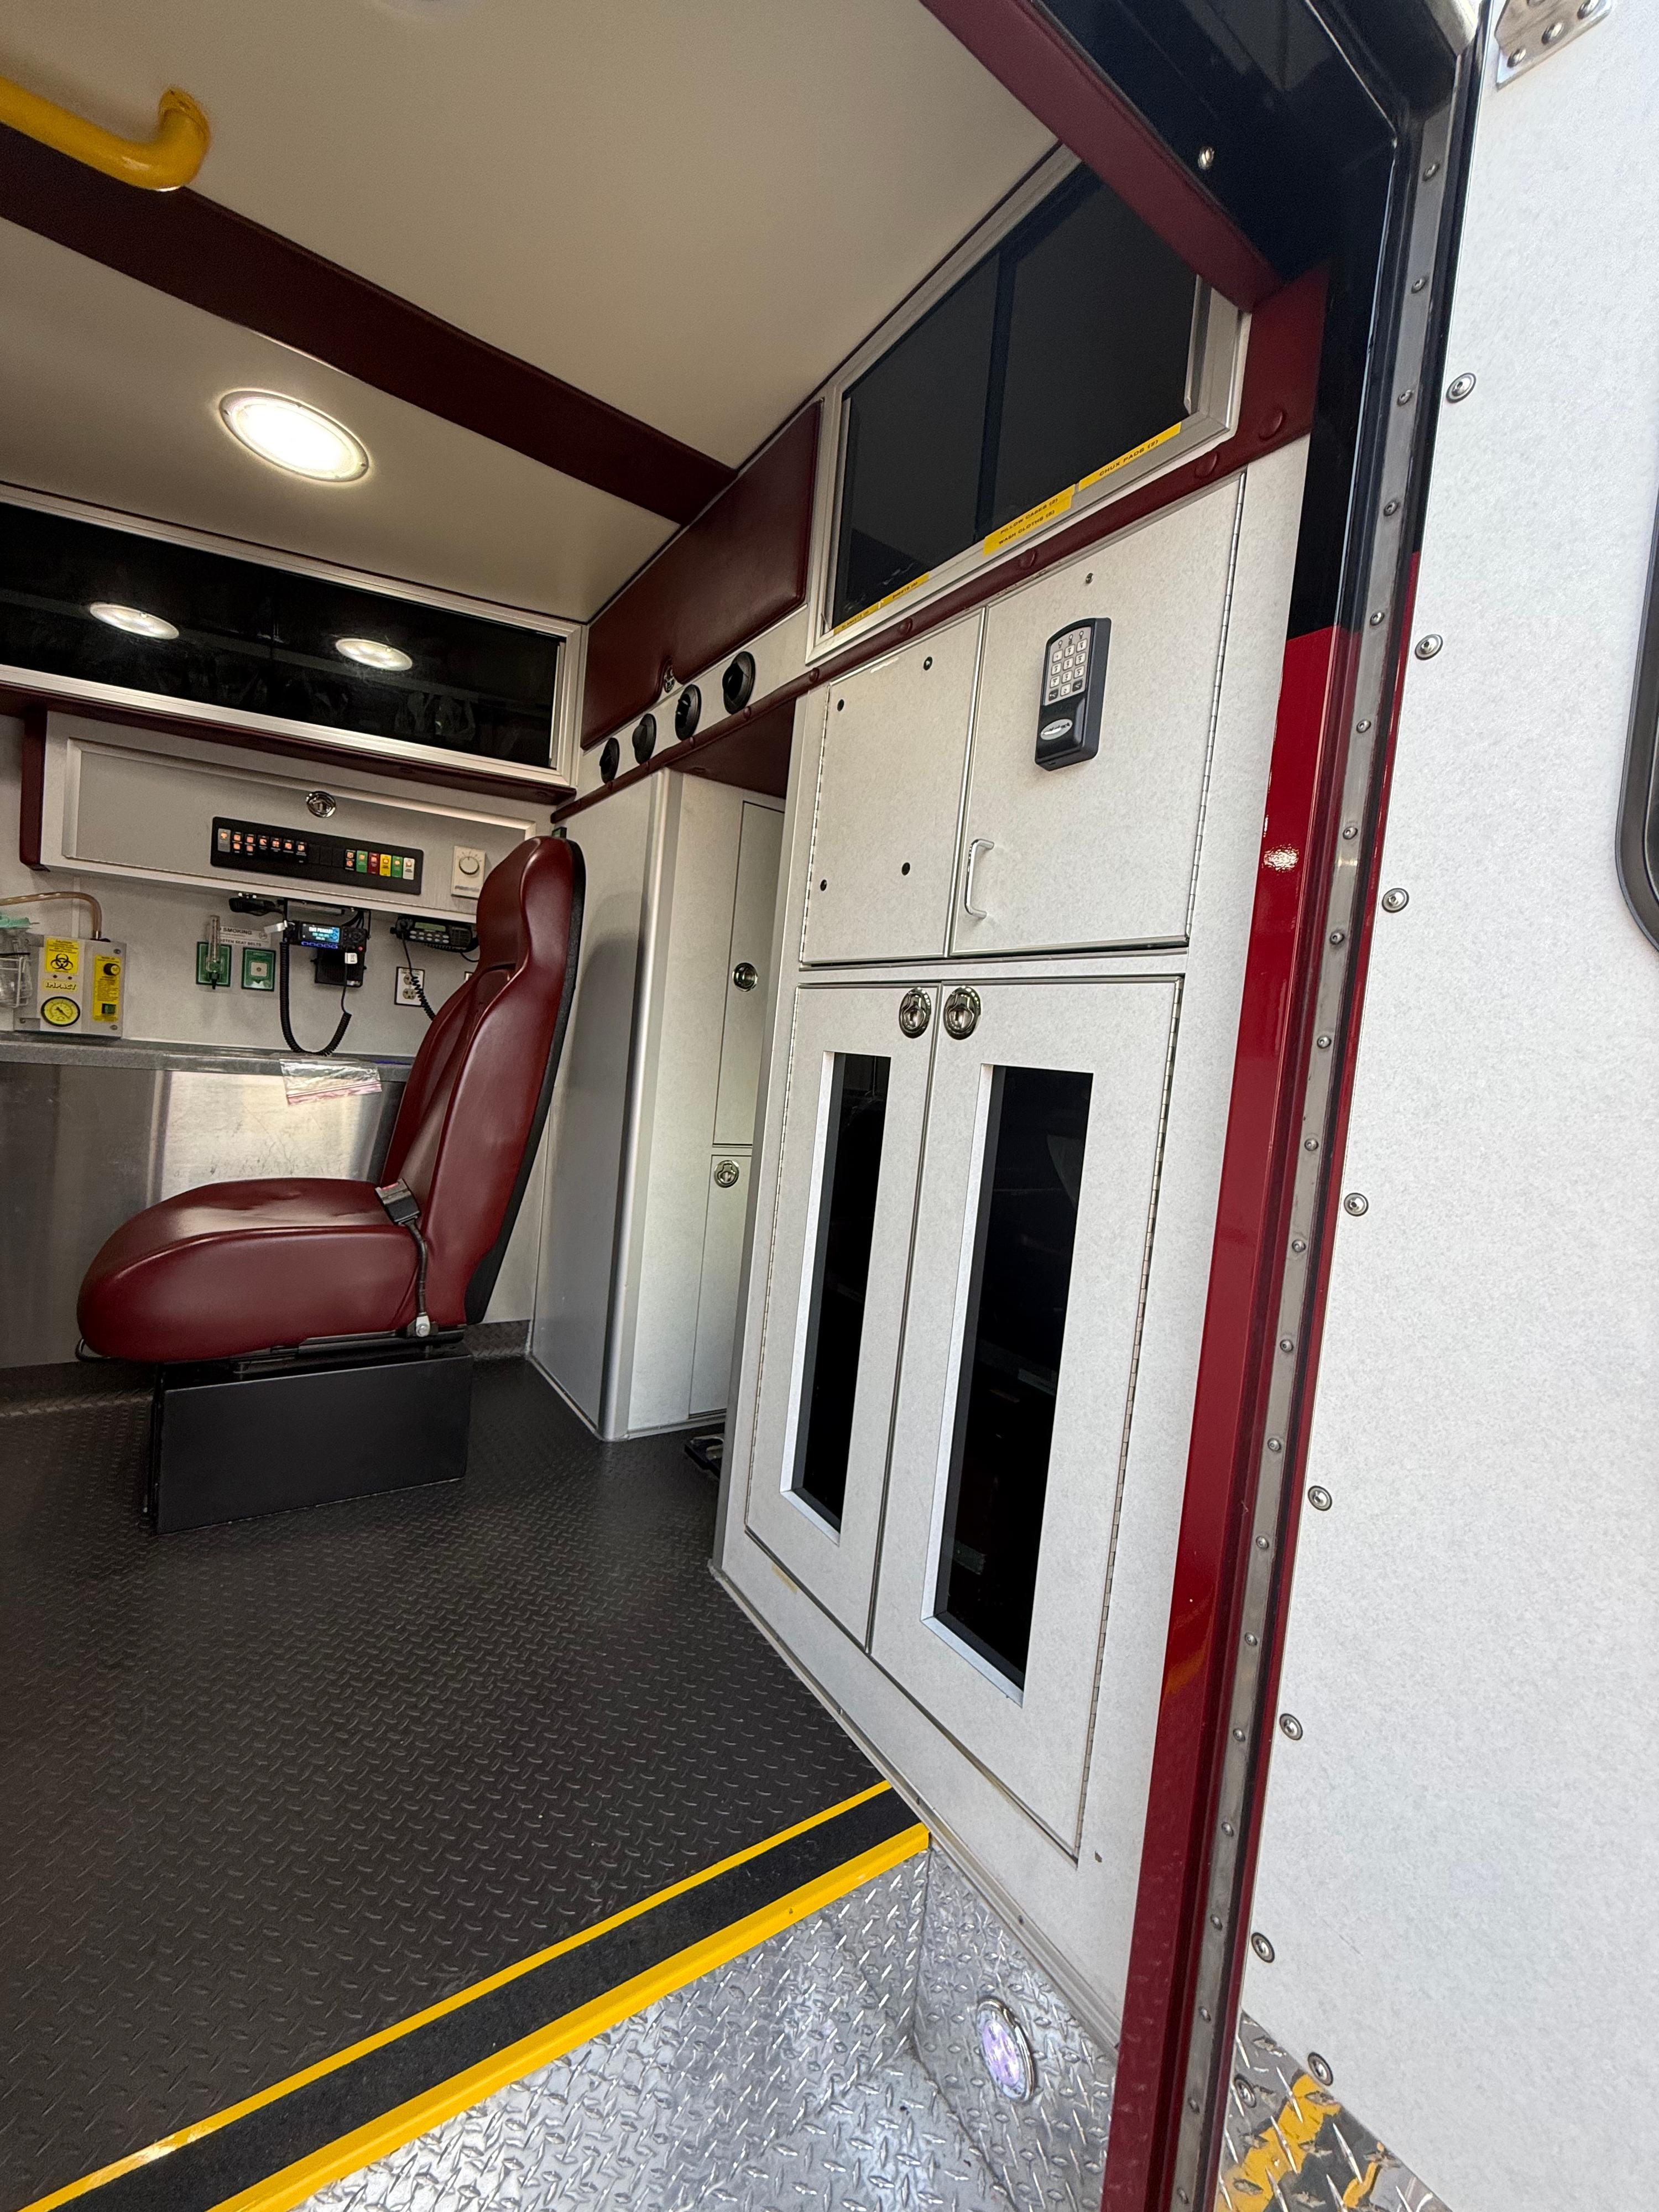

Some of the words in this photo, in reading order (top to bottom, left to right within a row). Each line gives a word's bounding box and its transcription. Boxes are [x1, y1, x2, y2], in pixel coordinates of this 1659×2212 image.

[1099, 461, 1120, 476] CHUX
[1123, 447, 1145, 462] PADS
[999, 533, 1016, 545] WASH
[1018, 516, 1044, 534] CLOTHS
[1000, 518, 1024, 534] PILLOW
[1025, 504, 1047, 519] CASES
[223, 927, 253, 936] SMOKING
[45, 982, 76, 990] IMPACT
